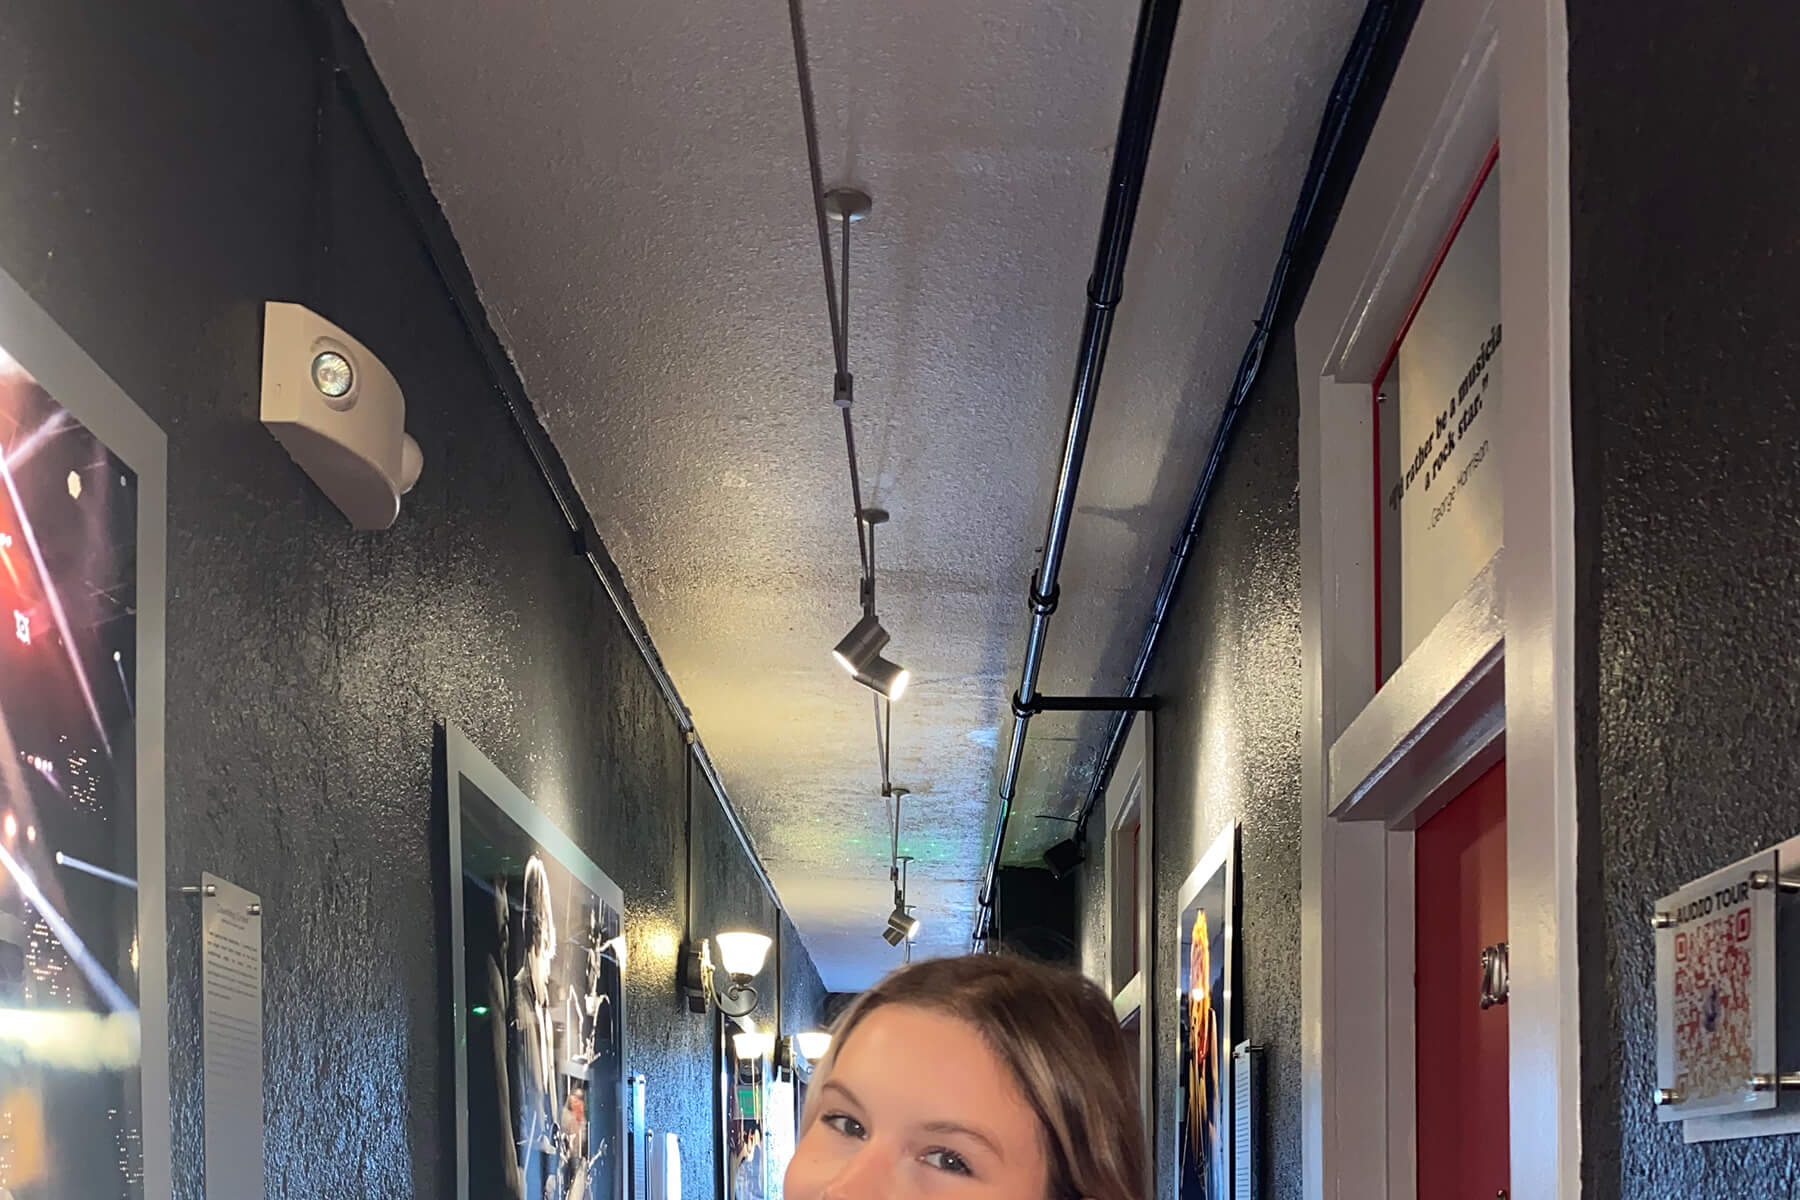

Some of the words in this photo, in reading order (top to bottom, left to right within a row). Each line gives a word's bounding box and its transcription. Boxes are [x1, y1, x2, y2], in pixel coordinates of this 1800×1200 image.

[1405, 432, 1434, 491] rather
[1436, 411, 1447, 440] be
[1450, 397, 1456, 418] a
[1458, 323, 1502, 406] musicia
[1425, 471, 1431, 491] a
[1432, 431, 1455, 480] rock
[1715, 881, 1749, 911] TOUR
